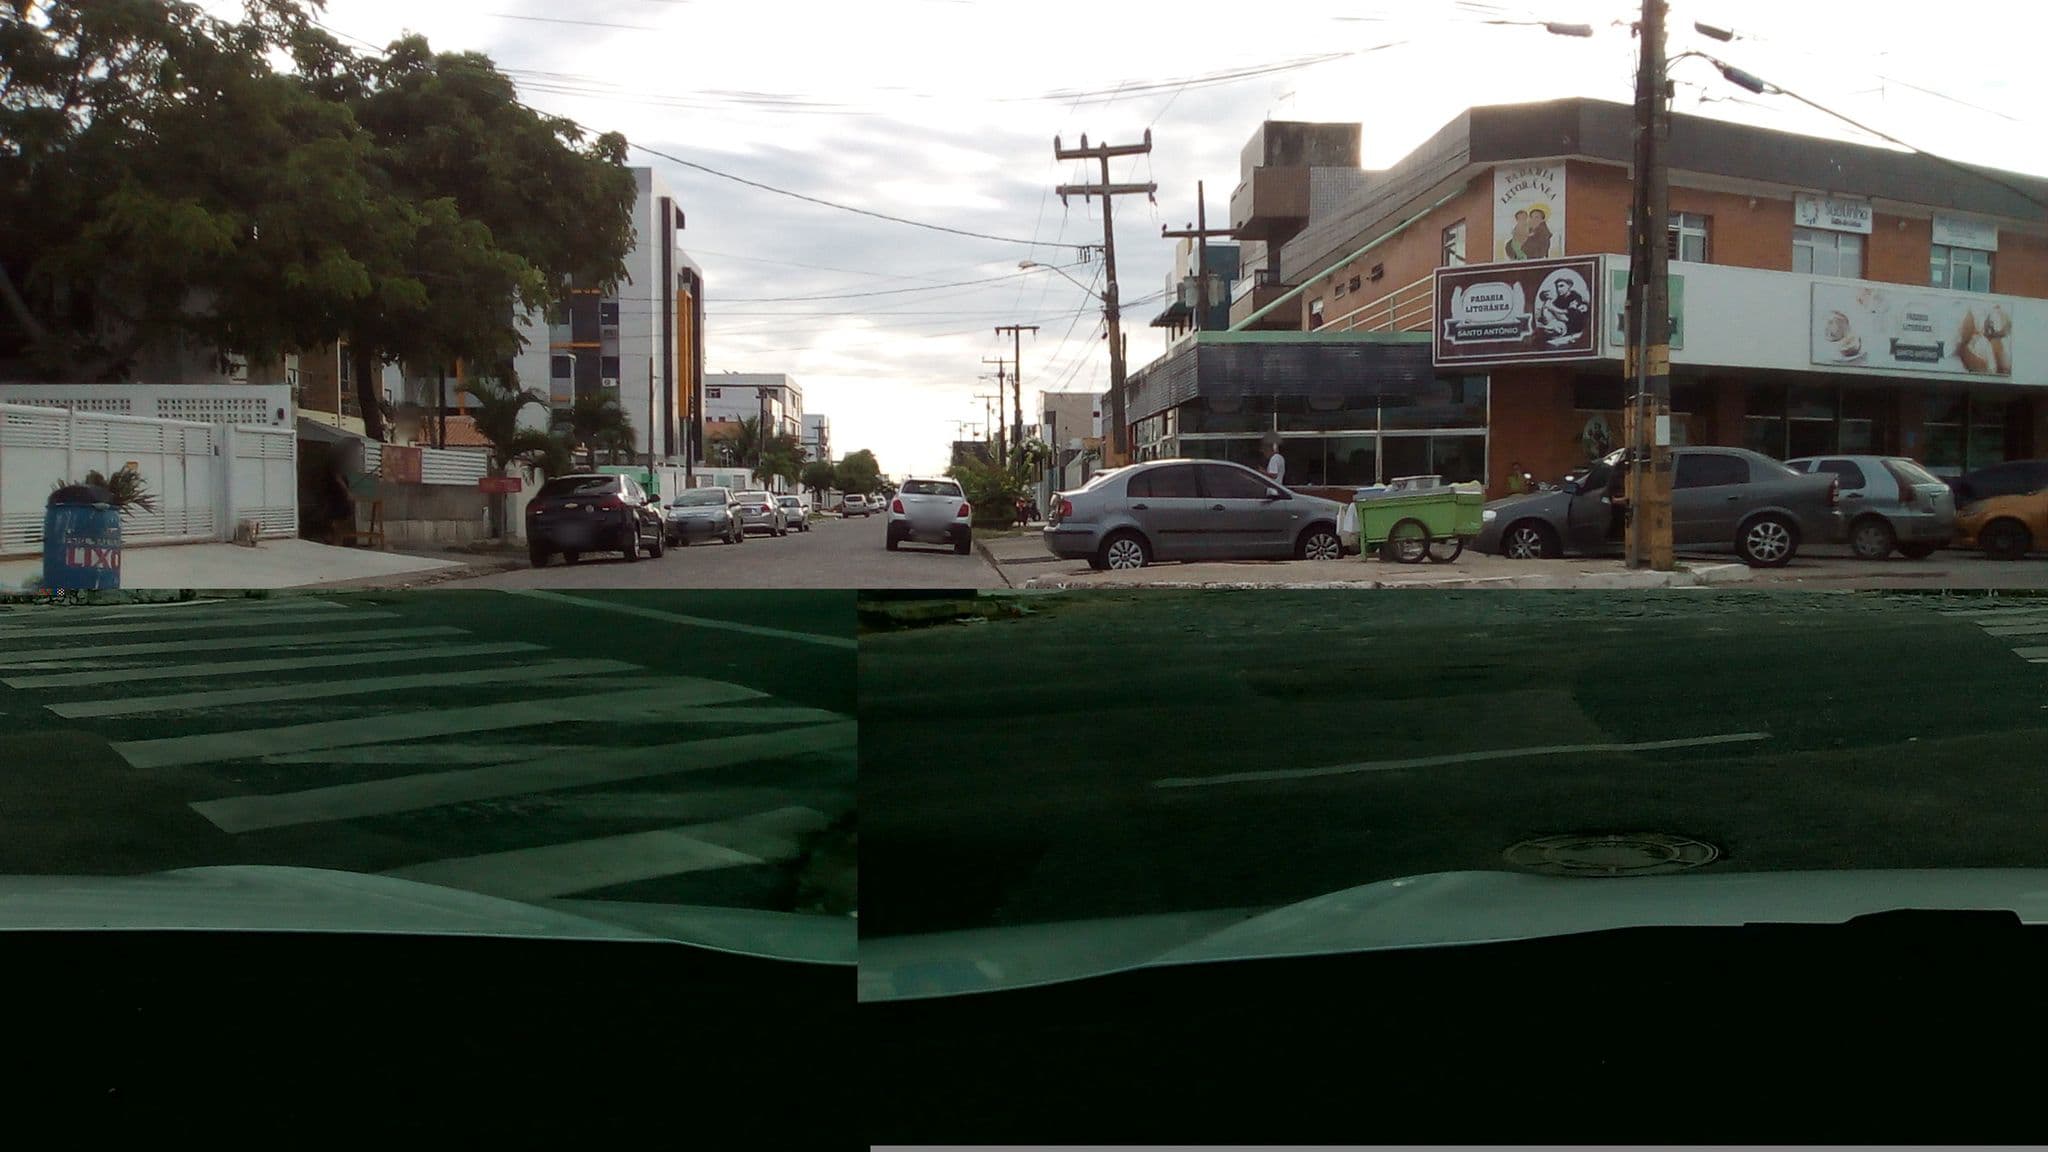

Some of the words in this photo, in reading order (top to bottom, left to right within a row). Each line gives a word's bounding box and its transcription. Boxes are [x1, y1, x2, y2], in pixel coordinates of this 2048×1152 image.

[1470, 294, 1504, 303] PADARIA
[1457, 329, 1483, 338] SANTO
[1483, 326, 1519, 336] ANTÔNIO
[66, 547, 120, 569] LIXO
